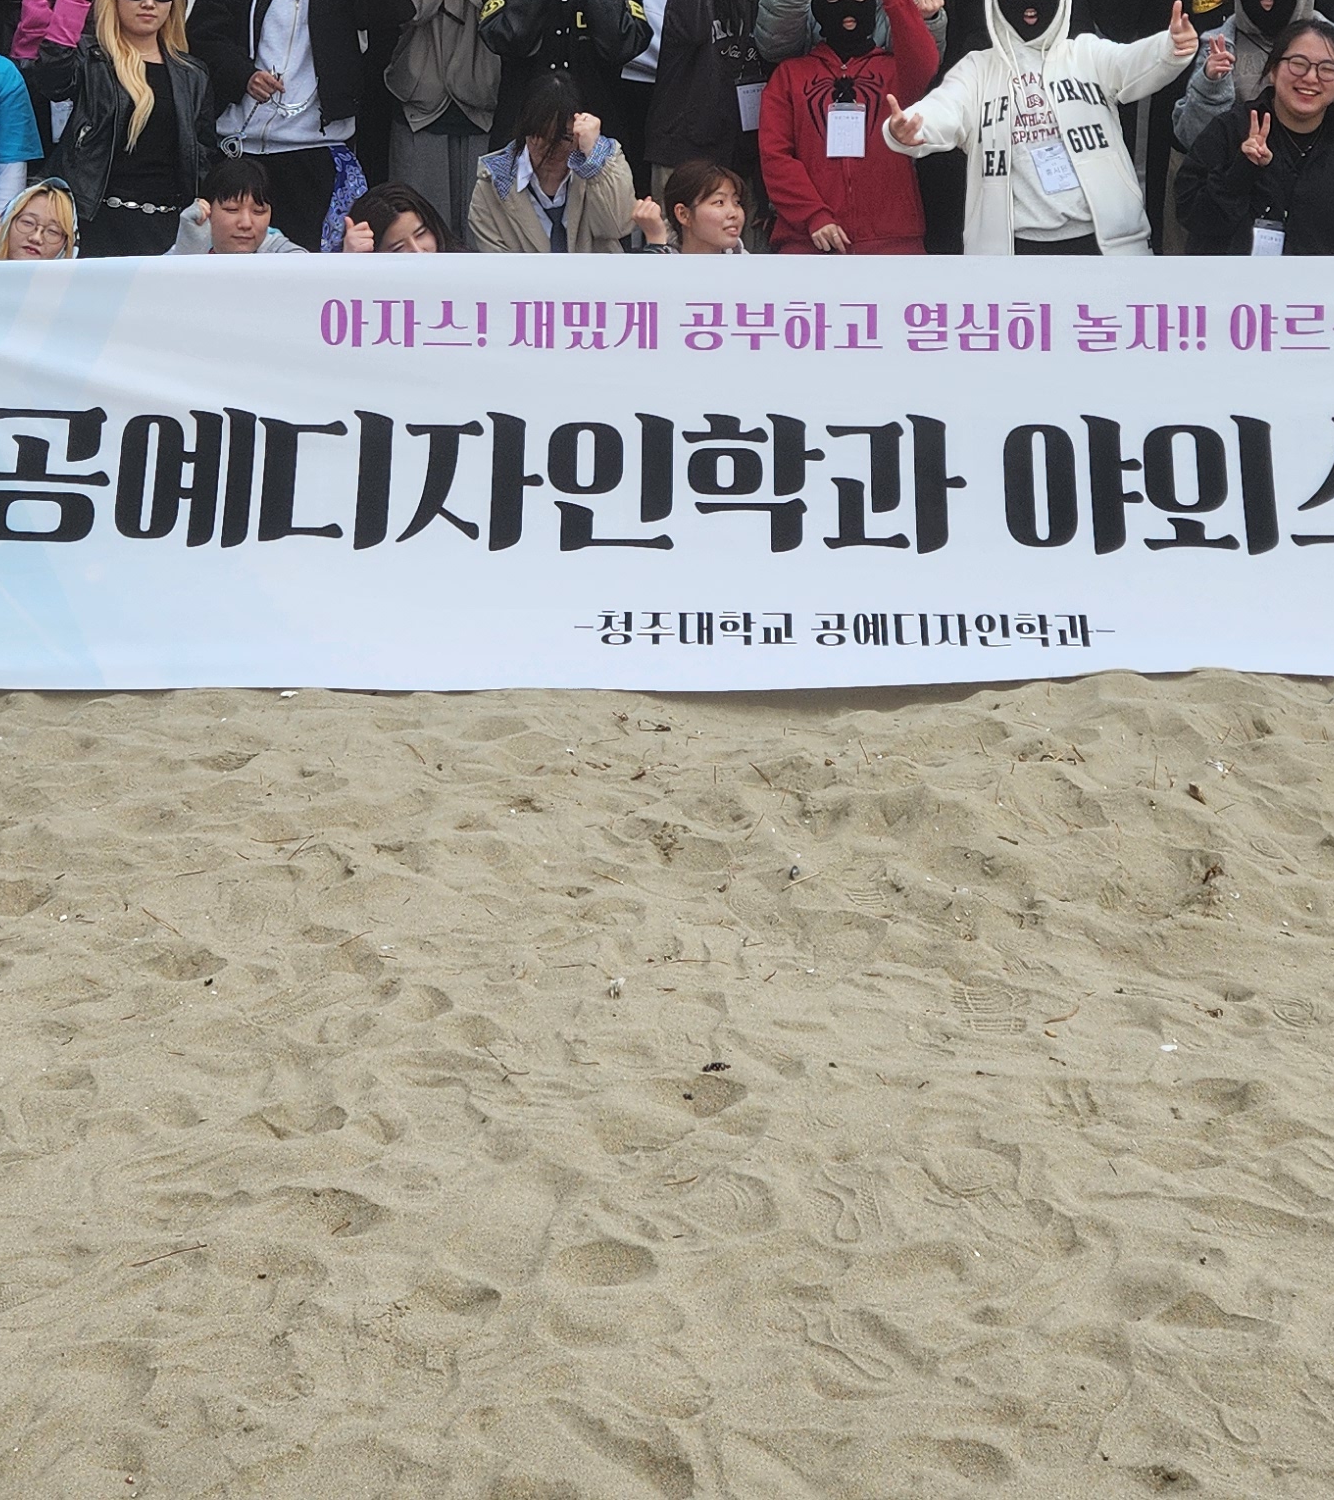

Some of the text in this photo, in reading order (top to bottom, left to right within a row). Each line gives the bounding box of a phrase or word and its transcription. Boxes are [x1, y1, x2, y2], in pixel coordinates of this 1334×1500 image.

[320, 298, 488, 348] 아자스!
[507, 300, 658, 351] 재밌게
[679, 301, 884, 351] 공부하고
[903, 301, 1051, 352] 열심히
[1072, 302, 1207, 353] 놀자!!
